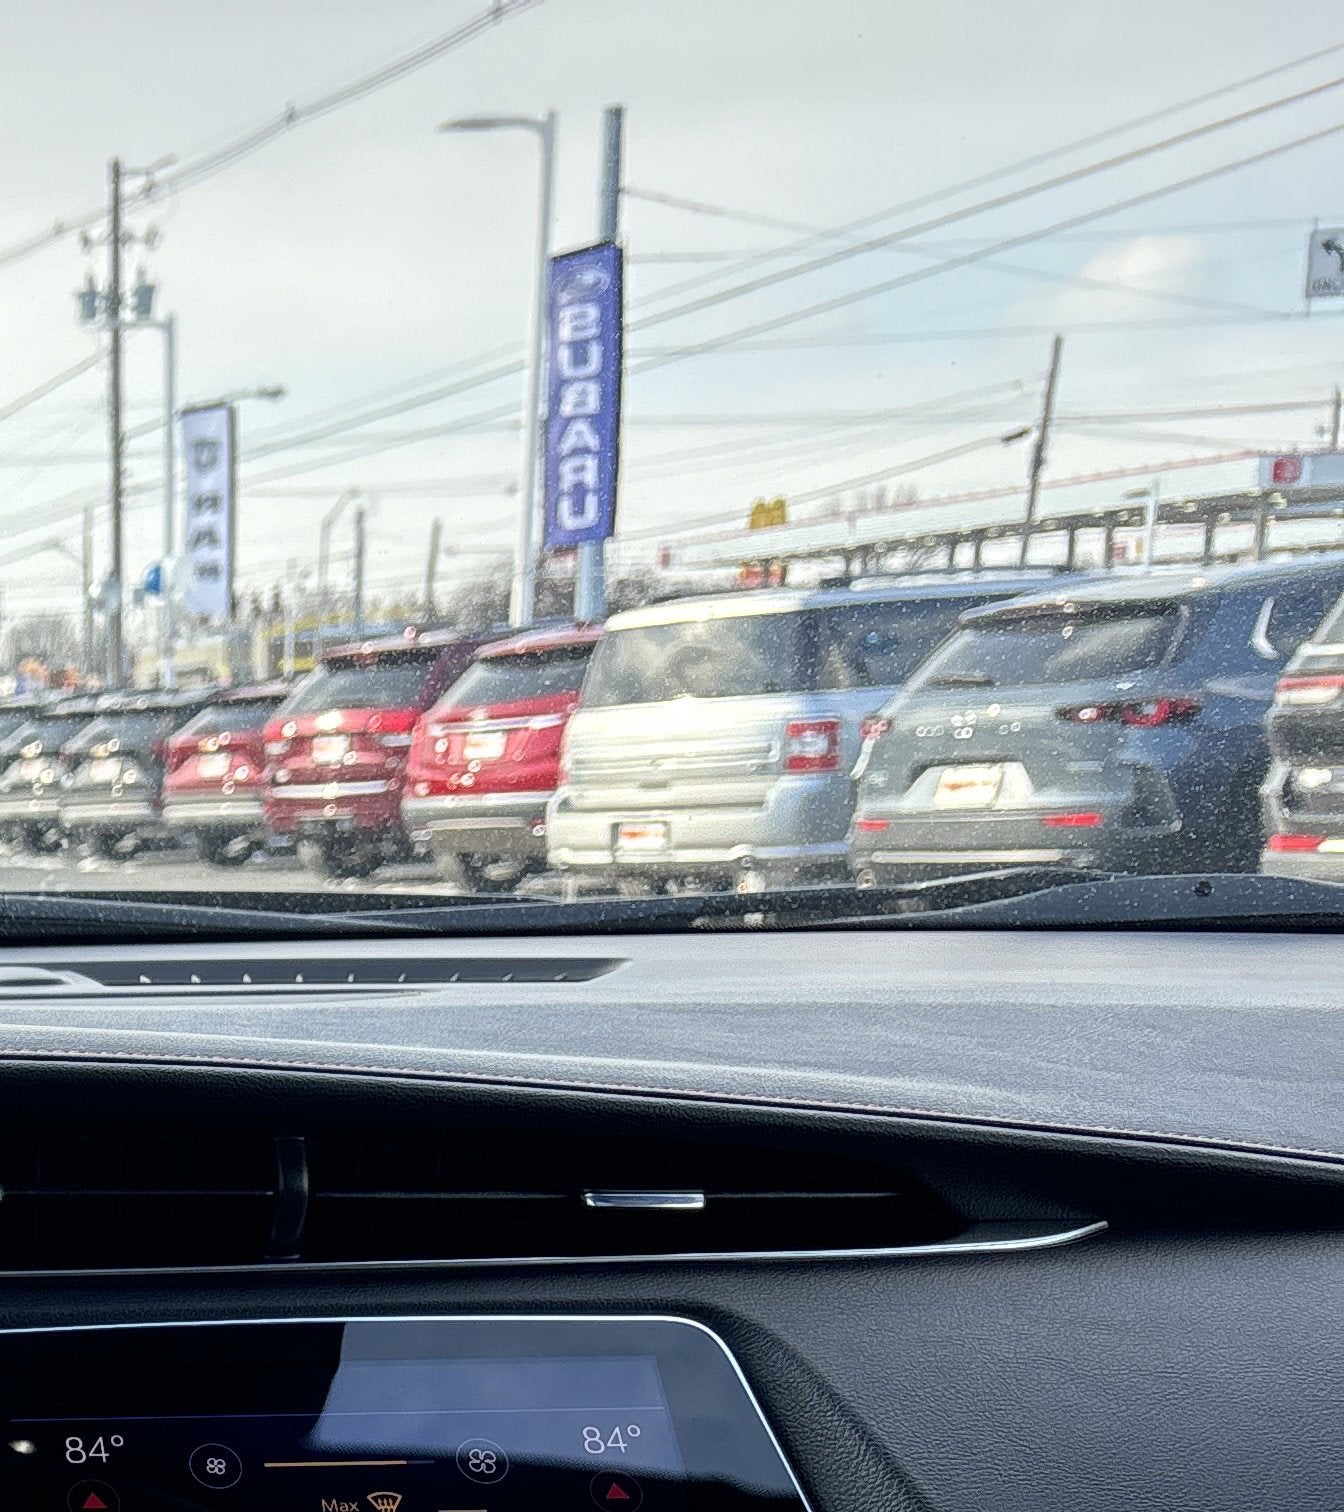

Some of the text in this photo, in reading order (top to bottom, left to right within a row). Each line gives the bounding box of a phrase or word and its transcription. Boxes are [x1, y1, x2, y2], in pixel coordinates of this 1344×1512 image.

[556, 300, 604, 531] SUBARU
[64, 1433, 125, 1463] 84°
[581, 1424, 642, 1454] 84°
[320, 1497, 360, 1512] Max
